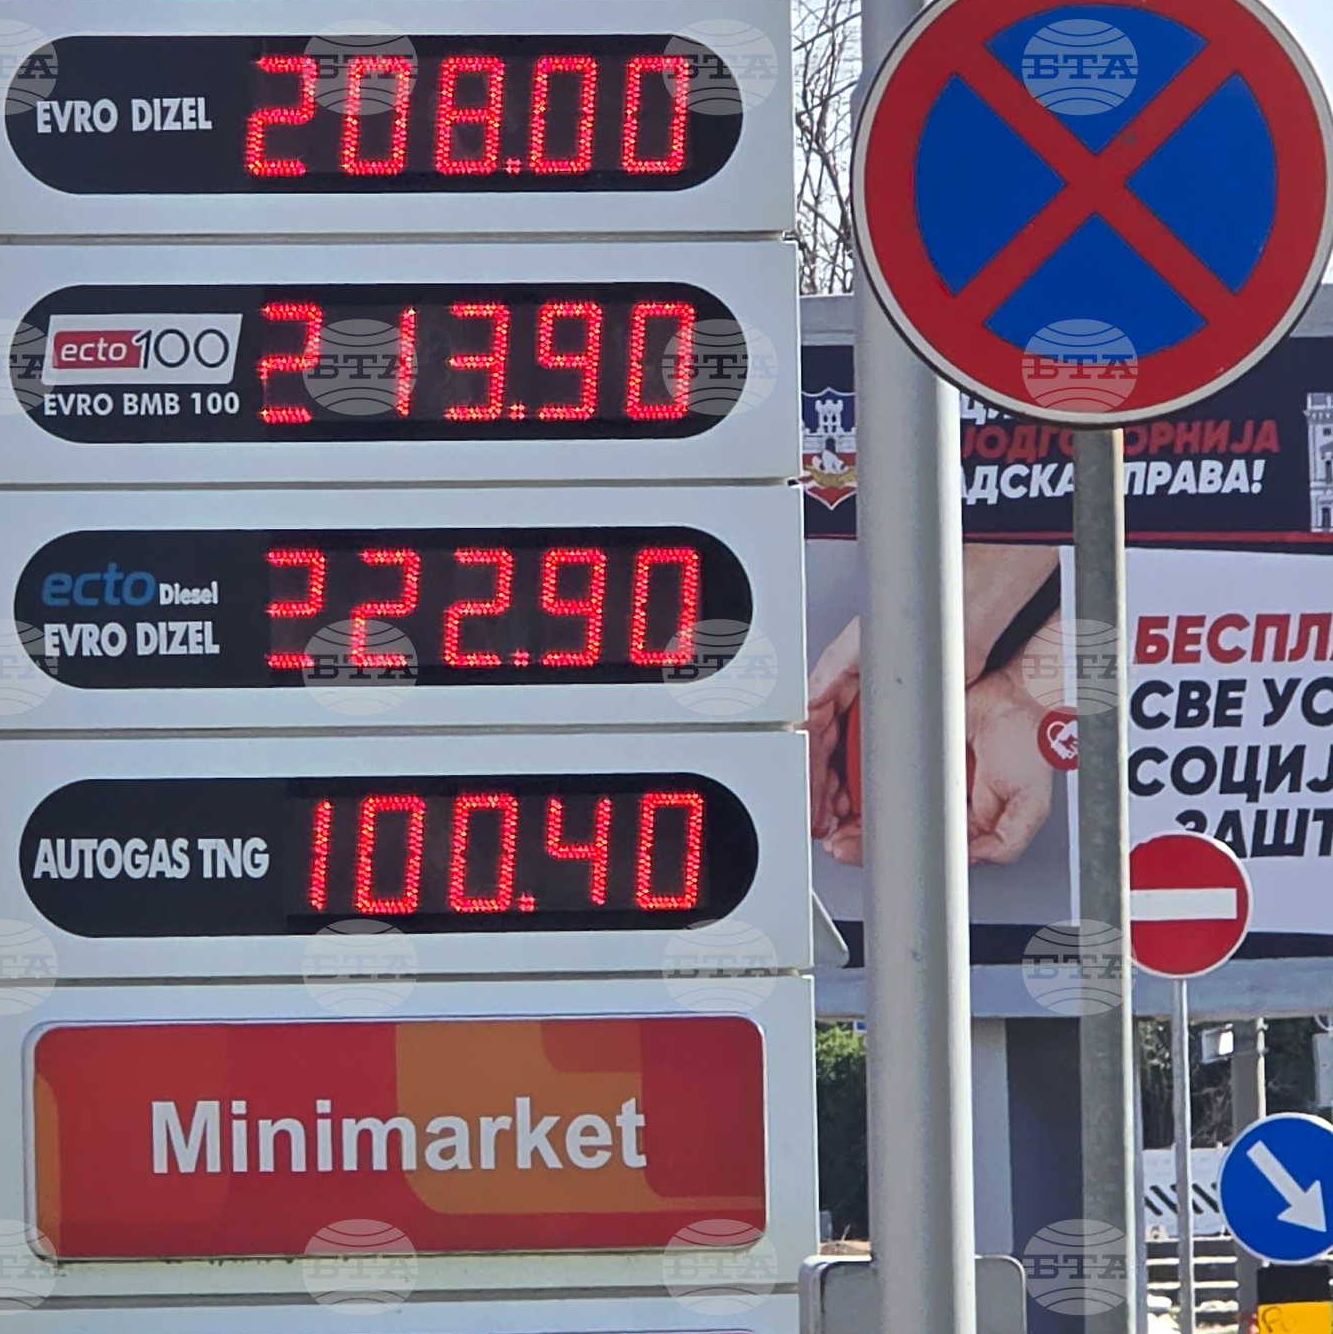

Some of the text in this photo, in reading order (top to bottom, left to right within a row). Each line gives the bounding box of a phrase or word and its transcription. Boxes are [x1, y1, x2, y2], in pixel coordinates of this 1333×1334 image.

[35, 96, 213, 134] EVRO DIZEL
[244, 55, 691, 177] 208.00
[42, 391, 240, 416] EVRO BMB 100
[1124, 459, 1266, 496] ПРАВА!
[42, 563, 219, 607] ecto Diesel
[43, 621, 221, 657] EVRO DIZEL
[1133, 612, 1333, 665] БЕСПЛ
[1130, 678, 1247, 730] СВЕ
[32, 837, 270, 879] AUTOGAS TNG
[308, 792, 705, 915] 100.40
[151, 1096, 648, 1174] Minimarket
